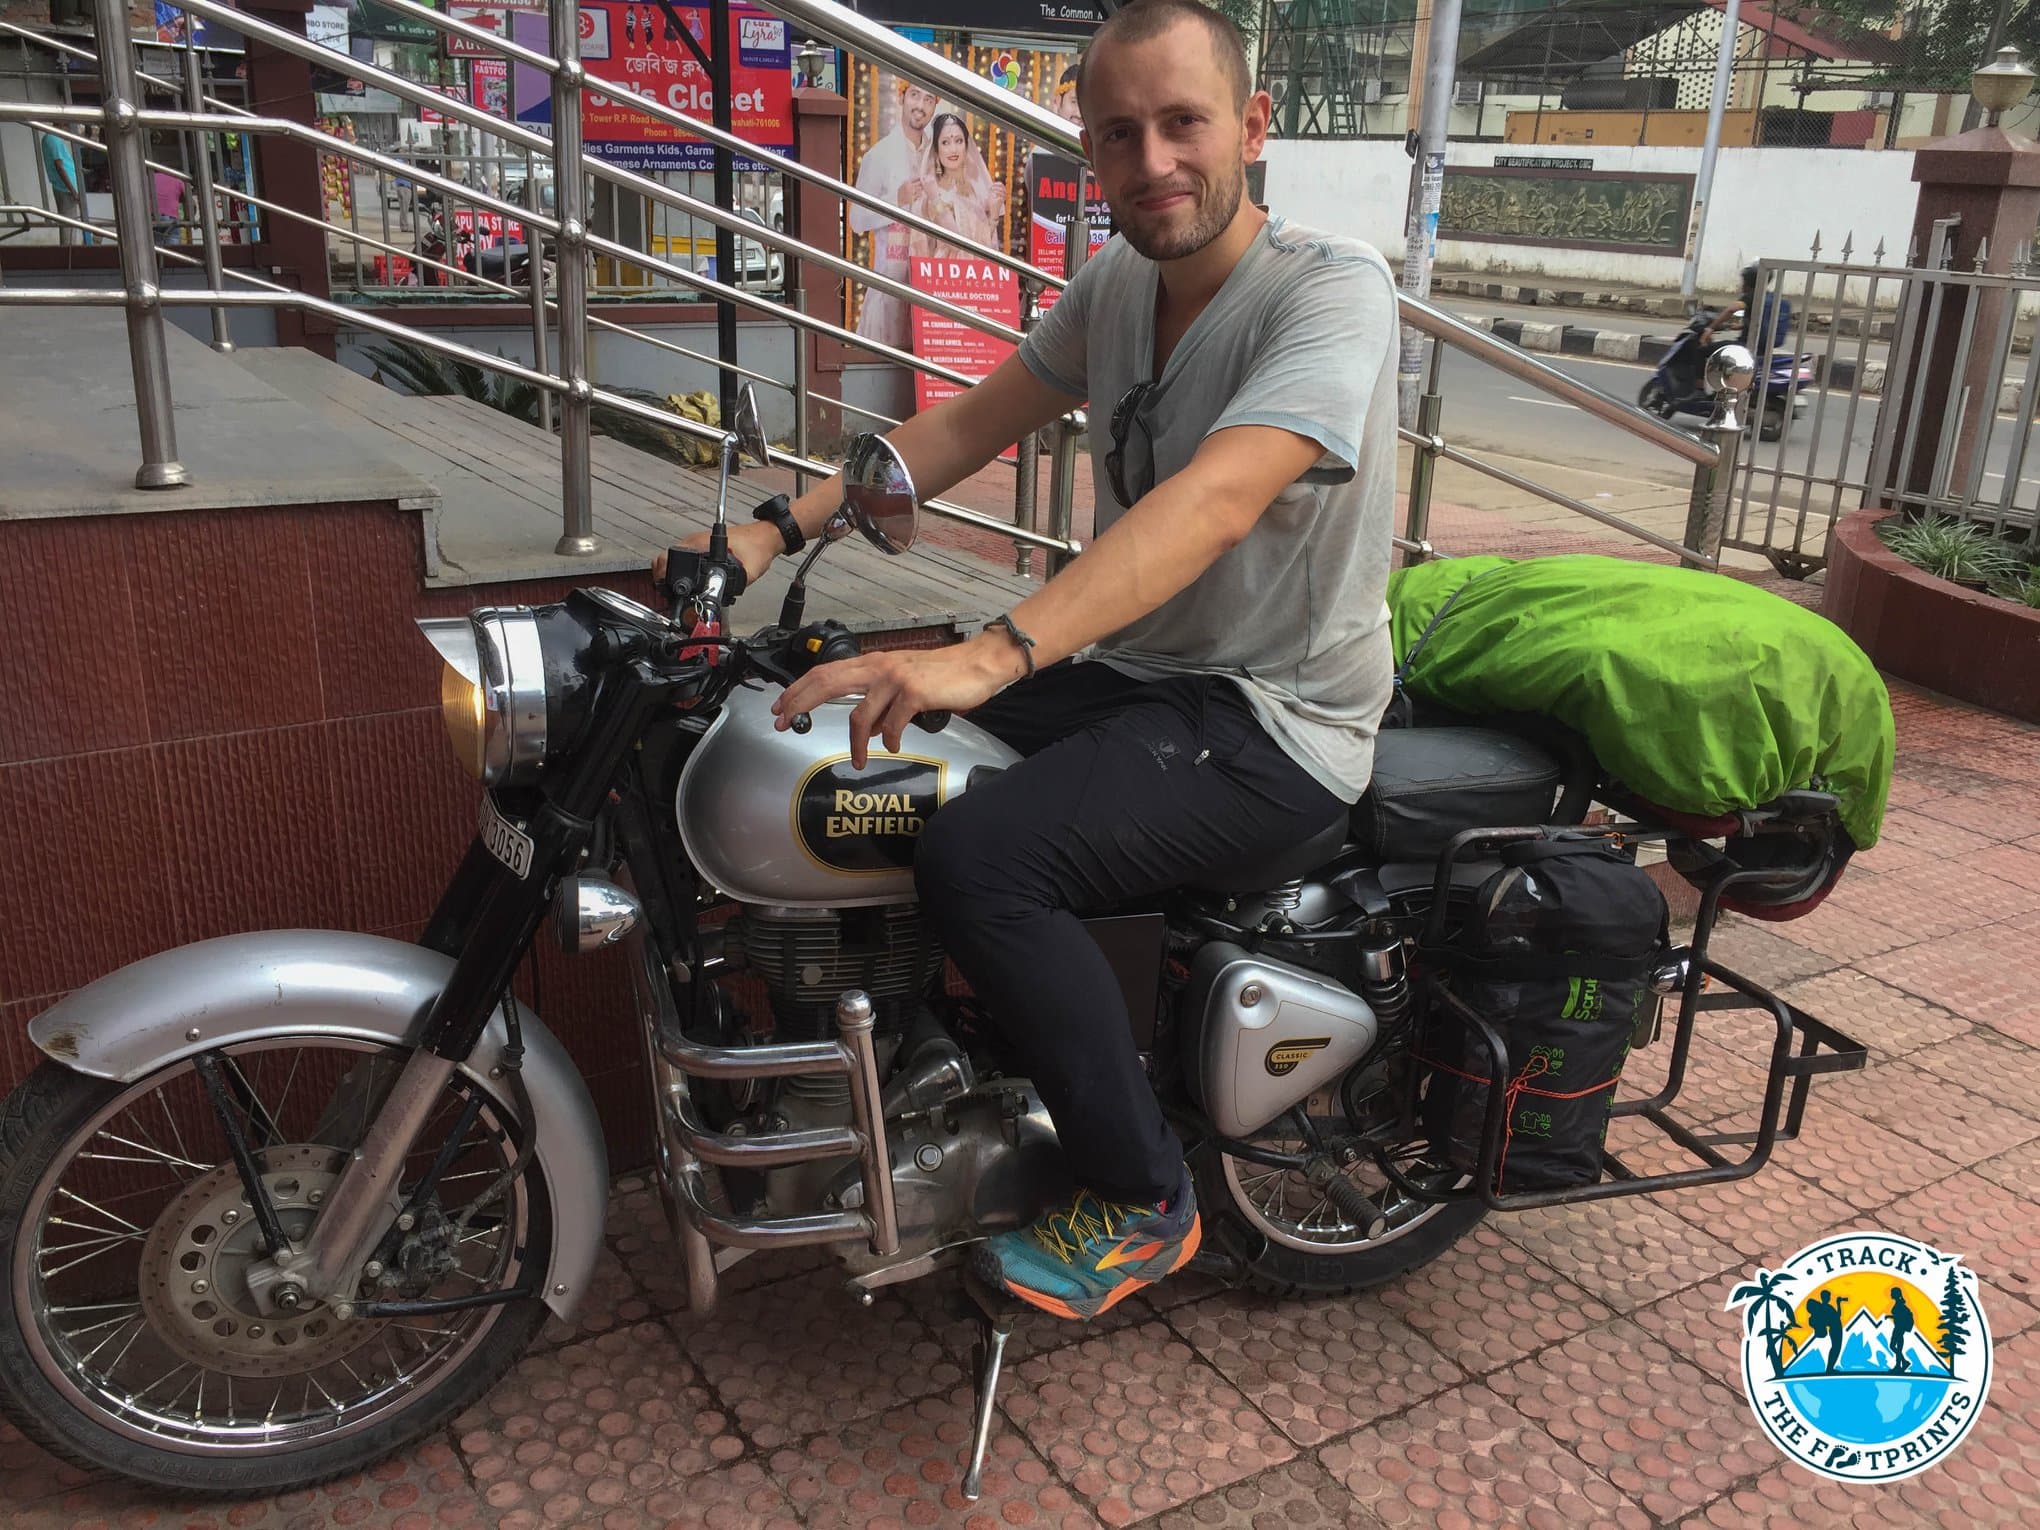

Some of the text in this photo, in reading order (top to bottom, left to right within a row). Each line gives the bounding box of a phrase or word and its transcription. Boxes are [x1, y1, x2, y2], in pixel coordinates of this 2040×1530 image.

[1040, 3, 1056, 17] The
[1060, 5, 1094, 20] Common
[322, 21, 345, 30] STORE
[667, 83, 765, 113] Cloet
[630, 114, 650, 124] Road
[643, 127, 667, 137] Phone
[605, 143, 655, 154] Garments
[657, 144, 683, 156] Kids,
[642, 159, 696, 170] Arnaments
[491, 216, 520, 231] STRE
[1045, 231, 1065, 245] Call
[920, 262, 1010, 281] NIDAAN
[926, 278, 1004, 289] HEALTHCARE
[932, 291, 999, 301] AVAILABLE DOCTORS
[835, 789, 916, 815] ROYAL
[826, 816, 925, 838] ENFIELD
[1275, 1052, 1308, 1060] CLASSIC
